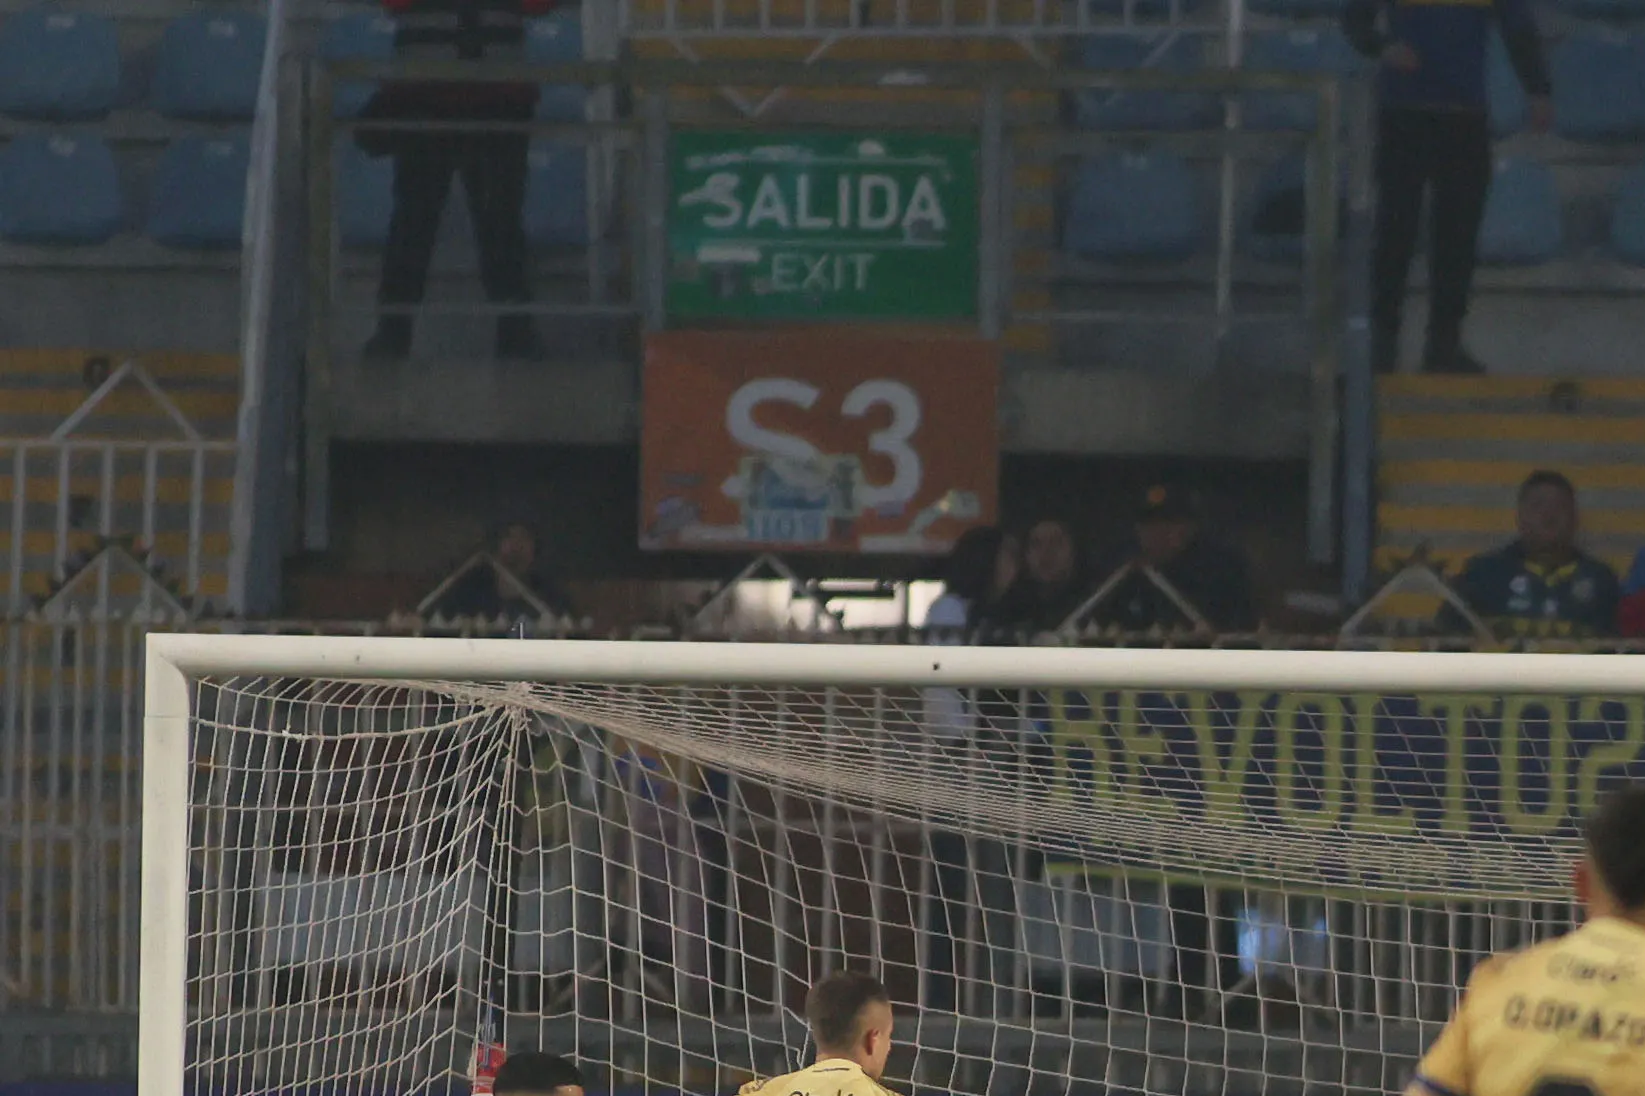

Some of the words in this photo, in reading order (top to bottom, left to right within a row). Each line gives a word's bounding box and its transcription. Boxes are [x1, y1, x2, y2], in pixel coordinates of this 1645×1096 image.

[700, 171, 946, 230] SALIDA
[771, 252, 874, 292] EXIT
[720, 376, 924, 506] S3
